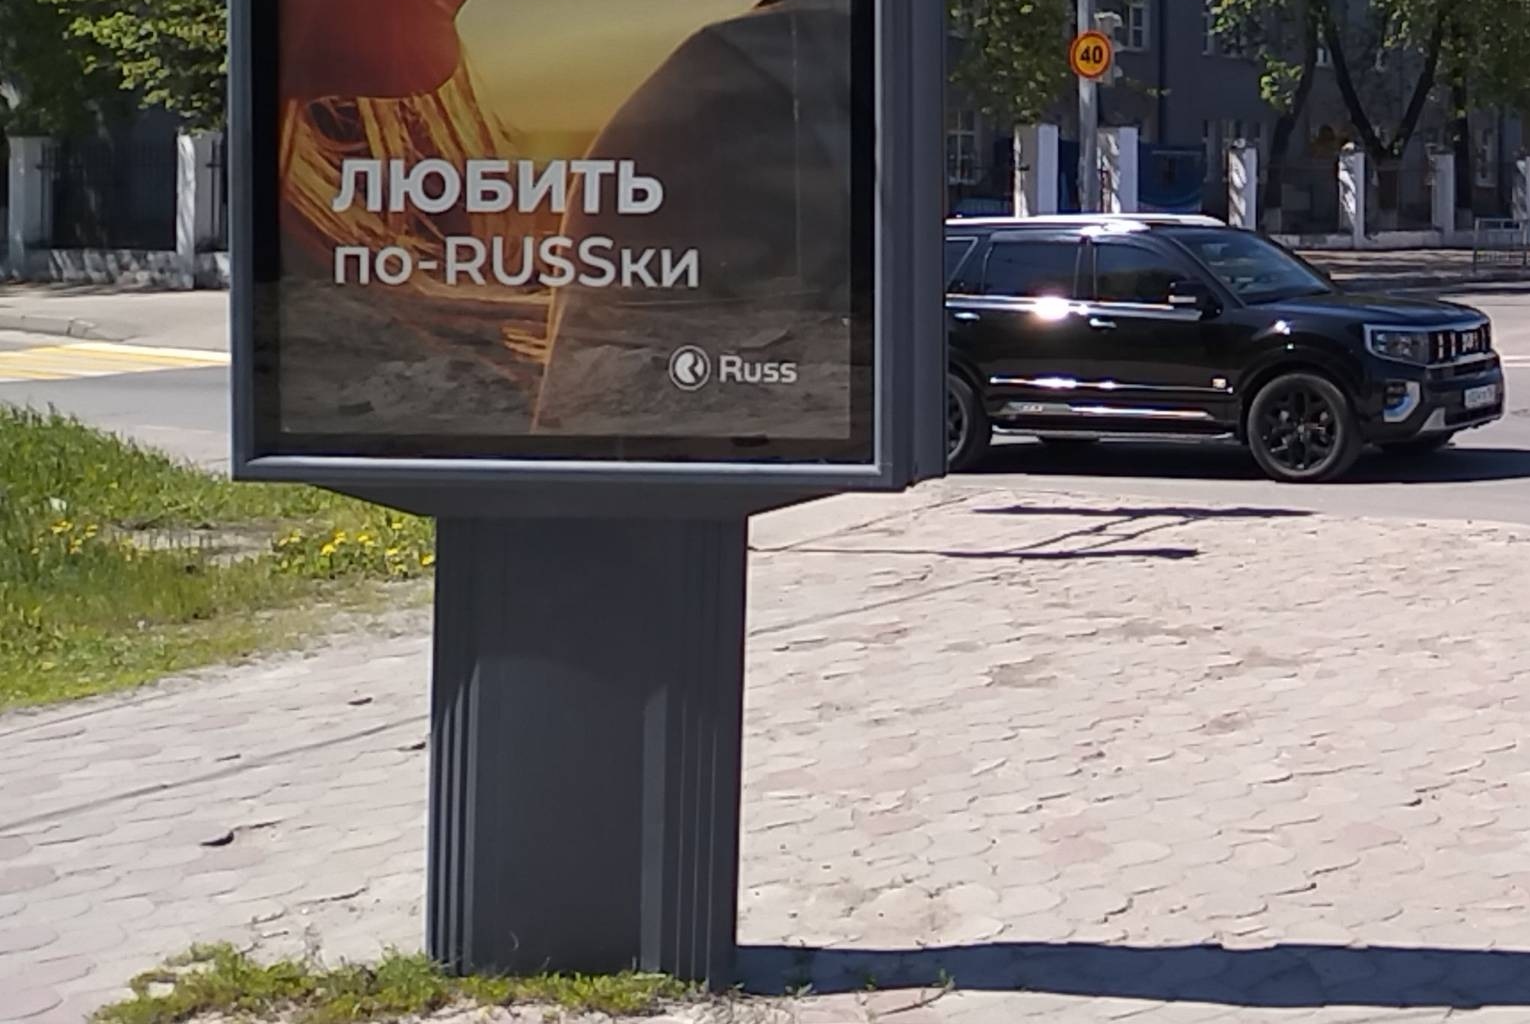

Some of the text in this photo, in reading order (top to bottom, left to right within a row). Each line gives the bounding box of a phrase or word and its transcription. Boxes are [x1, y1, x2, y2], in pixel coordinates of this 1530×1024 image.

[1080, 45, 1103, 64] 40
[333, 159, 664, 214] ЛЮБИТЬ
[335, 237, 699, 288] по-RUSSки
[720, 355, 798, 384] Russ
